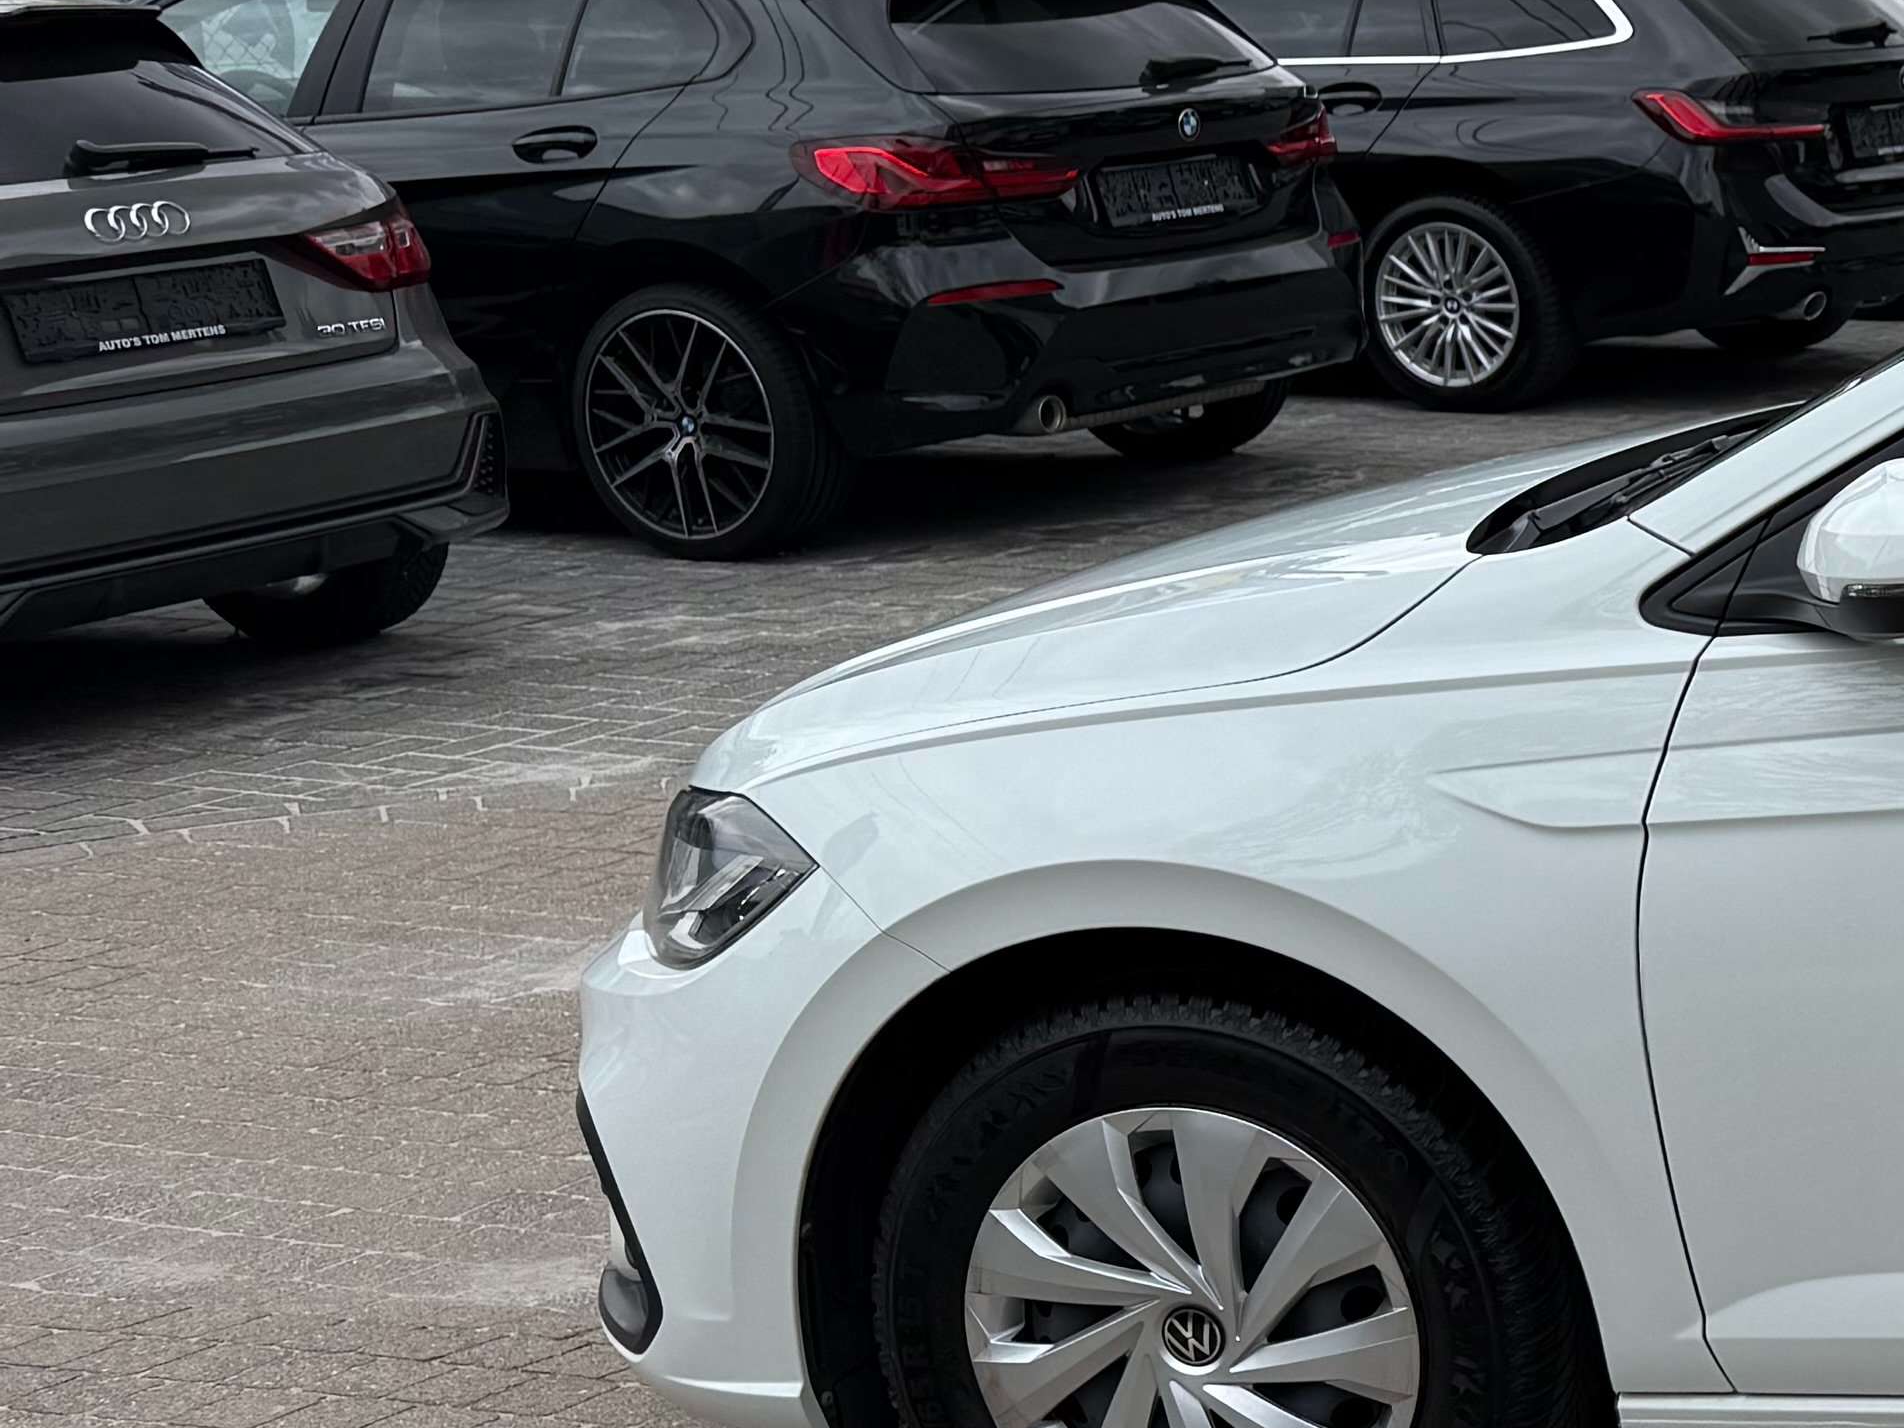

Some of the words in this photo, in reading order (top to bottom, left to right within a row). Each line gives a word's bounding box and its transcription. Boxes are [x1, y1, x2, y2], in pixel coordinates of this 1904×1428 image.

[98, 336, 142, 352] AUTO'S
[142, 332, 171, 346] TOM
[171, 324, 226, 341] MERTENS
